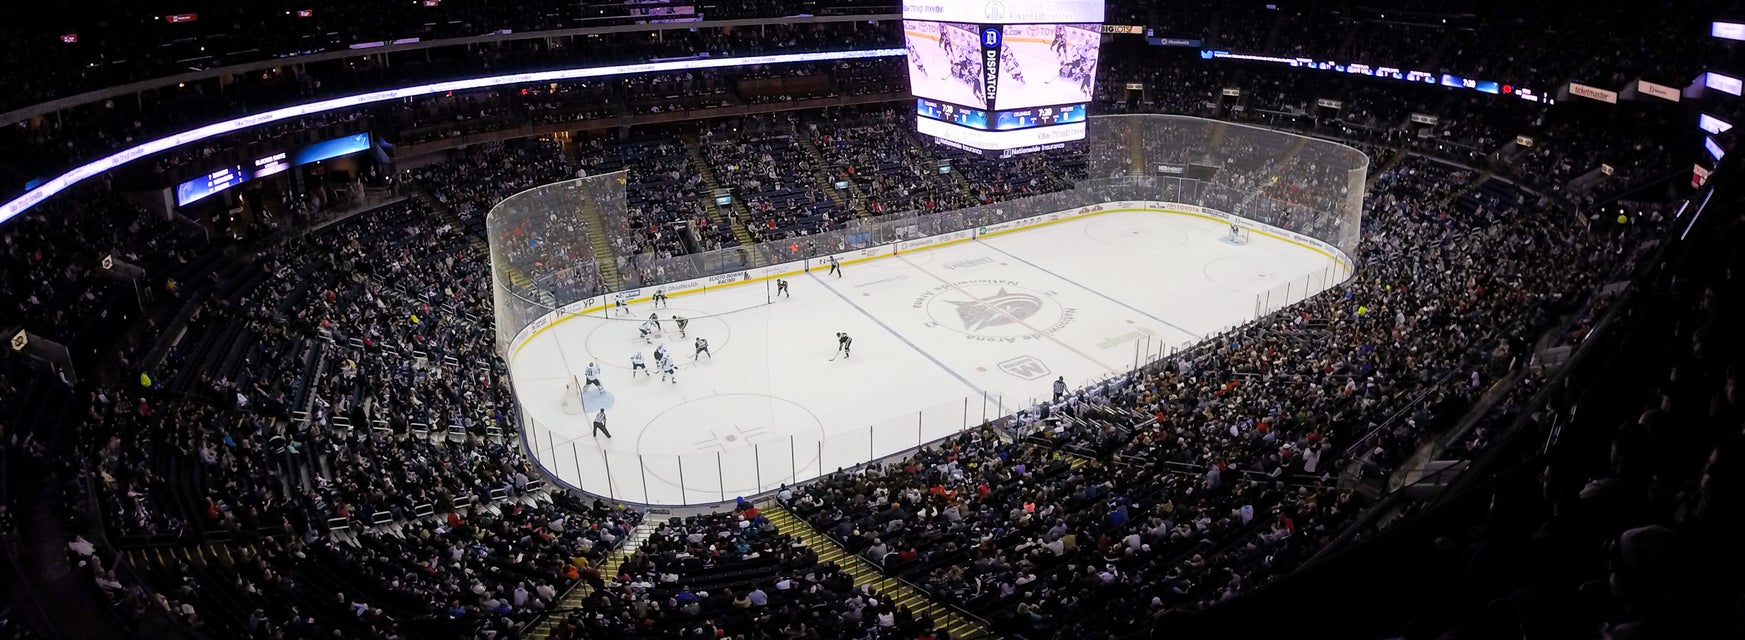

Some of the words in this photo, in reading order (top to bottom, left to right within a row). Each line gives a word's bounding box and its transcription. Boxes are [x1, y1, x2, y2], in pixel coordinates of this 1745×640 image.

[986, 50, 996, 100] DISPATCH
[1574, 86, 1609, 100] ticketmaster
[1012, 146, 1040, 155] Nationwide
[1041, 143, 1065, 151] Insurance
[1177, 204, 1200, 213] TOYOTA
[934, 278, 1020, 293] Nationwide
[582, 298, 595, 308] yp
[912, 290, 935, 310] Arena
[1021, 307, 1077, 343] Nationwide
[966, 333, 1016, 344] Arena
